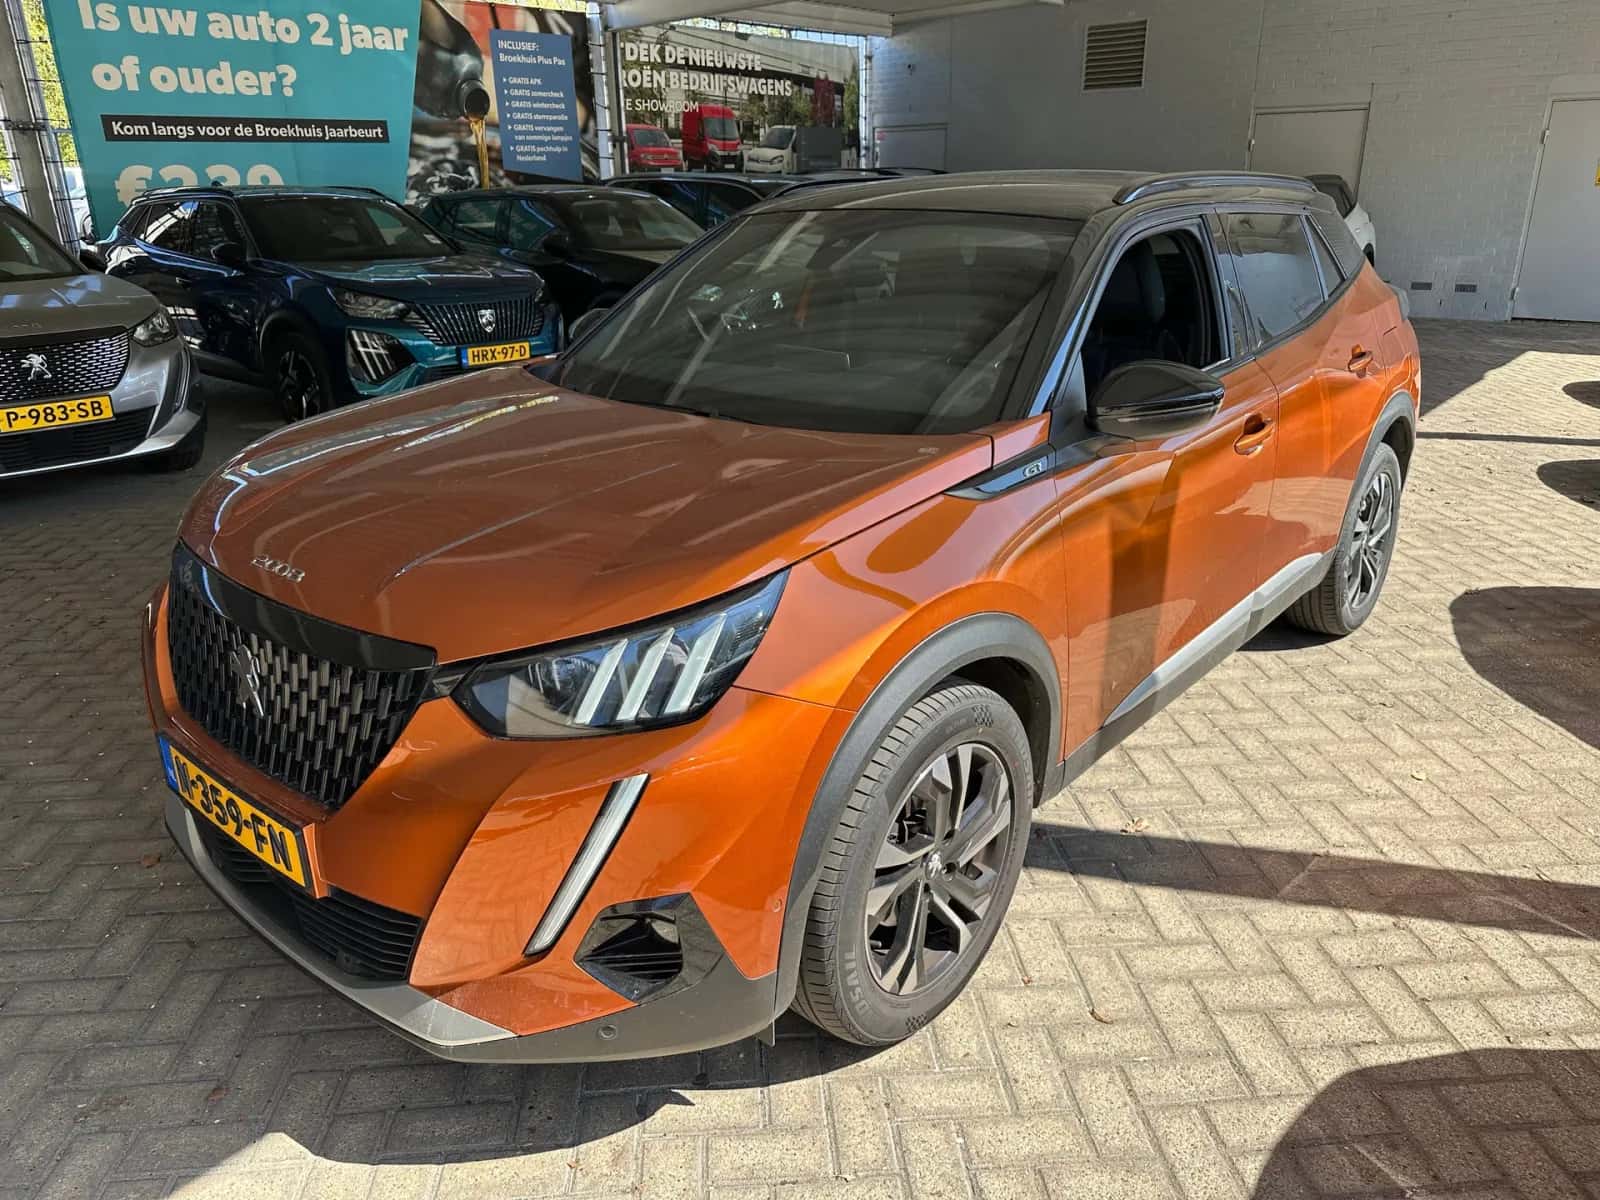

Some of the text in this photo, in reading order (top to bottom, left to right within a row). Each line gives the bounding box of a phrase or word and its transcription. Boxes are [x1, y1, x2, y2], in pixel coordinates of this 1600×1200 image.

[78, 0, 409, 55] Is uw auto 2 jaar
[498, 40, 539, 51] INCLUSIEF:
[499, 53, 566, 66] Broekhuis Plus Pas
[620, 41, 762, 72] DEK DE NIEUWSTE
[91, 54, 297, 97] of ouder?
[508, 76, 529, 84] GRATIS
[669, 71, 792, 97] BEDRIJFSWAGENS
[509, 88, 531, 97] GRATIS
[510, 100, 532, 108] GRATIS
[634, 99, 699, 113] SHOWROOM
[512, 112, 533, 120] GRATIS
[111, 121, 384, 141] Kom langs voor de Broekhuis Jaarbeurt
[513, 123, 534, 131] GRATIS
[515, 144, 537, 153] GRATIS
[471, 344, 527, 363] HRX-97-D
[6, 400, 104, 429] P-983-SB
[174, 755, 293, 872] N-359-FN
